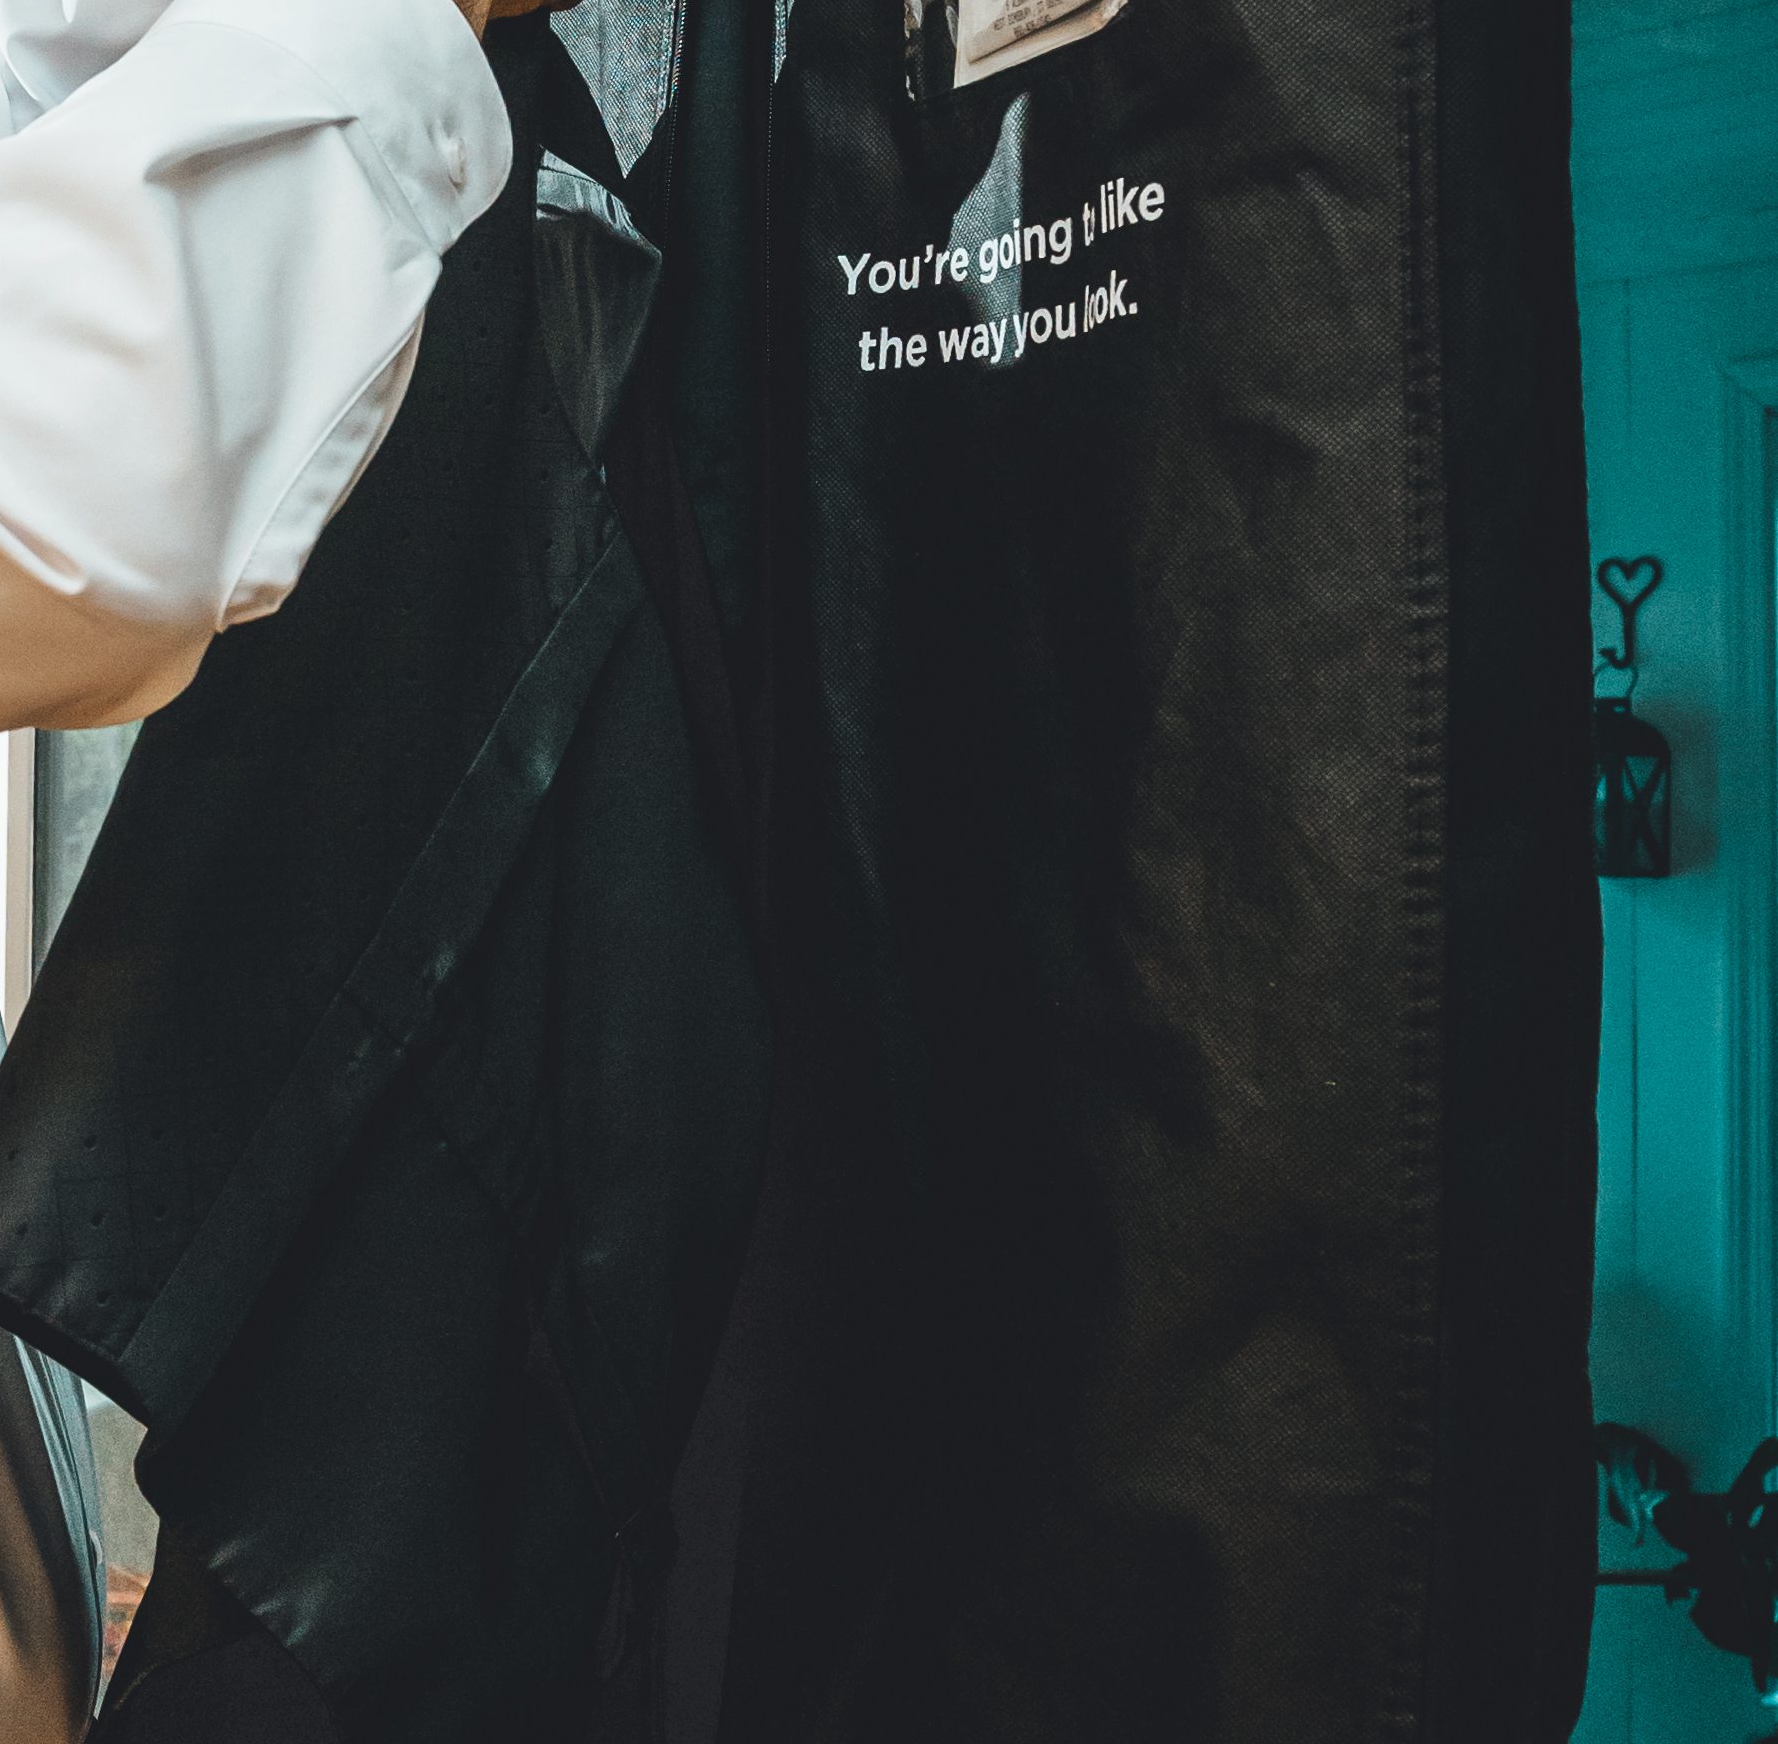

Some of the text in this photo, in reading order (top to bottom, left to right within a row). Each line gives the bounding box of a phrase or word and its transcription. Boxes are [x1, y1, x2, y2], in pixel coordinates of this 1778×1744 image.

[979, 217, 1073, 285] going
[1100, 177, 1166, 234] like
[858, 326, 928, 372] the
[937, 317, 1008, 364] way
[1013, 301, 1077, 358] you
